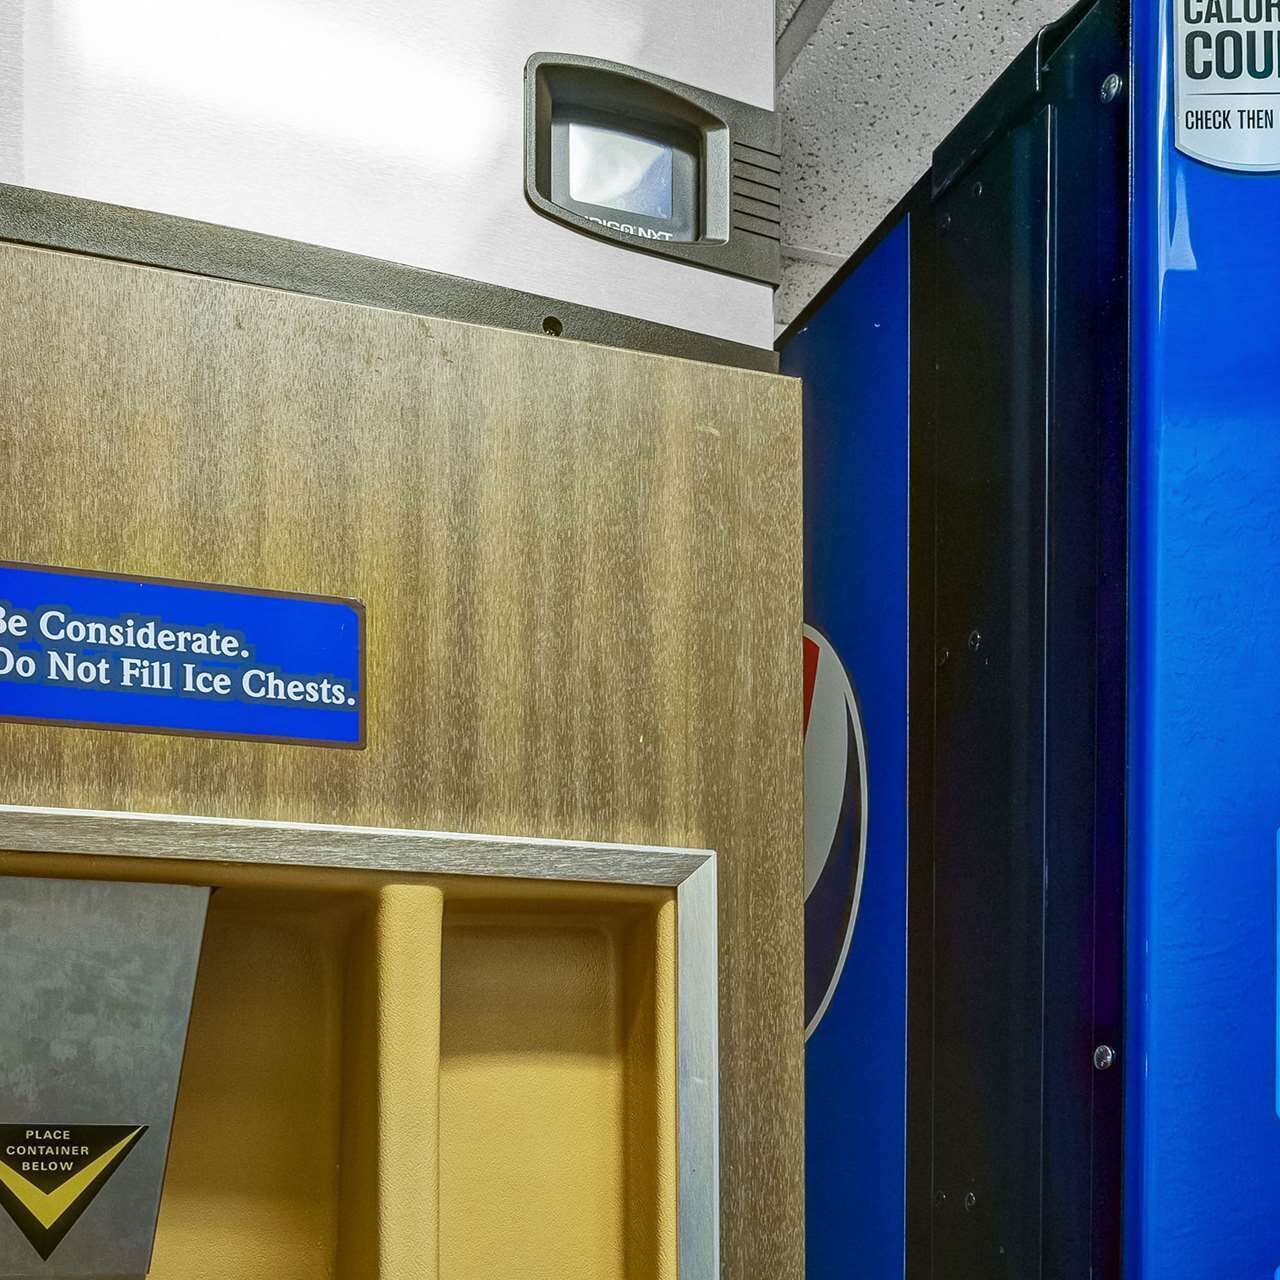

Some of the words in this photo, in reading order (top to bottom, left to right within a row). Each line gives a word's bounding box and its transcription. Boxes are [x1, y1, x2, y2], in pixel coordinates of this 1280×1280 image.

[1184, 109, 1232, 130] CHECK
[1237, 109, 1274, 129] THEN
[39, 610, 250, 658] Considerate.
[48, 652, 111, 685] Not
[120, 658, 172, 691] Fill
[184, 664, 232, 695] Ice
[241, 669, 357, 706] Chests.
[25, 1130, 71, 1140] PLACE
[6, 1146, 89, 1156] CONTAINER
[22, 1161, 74, 1171] BELOW
